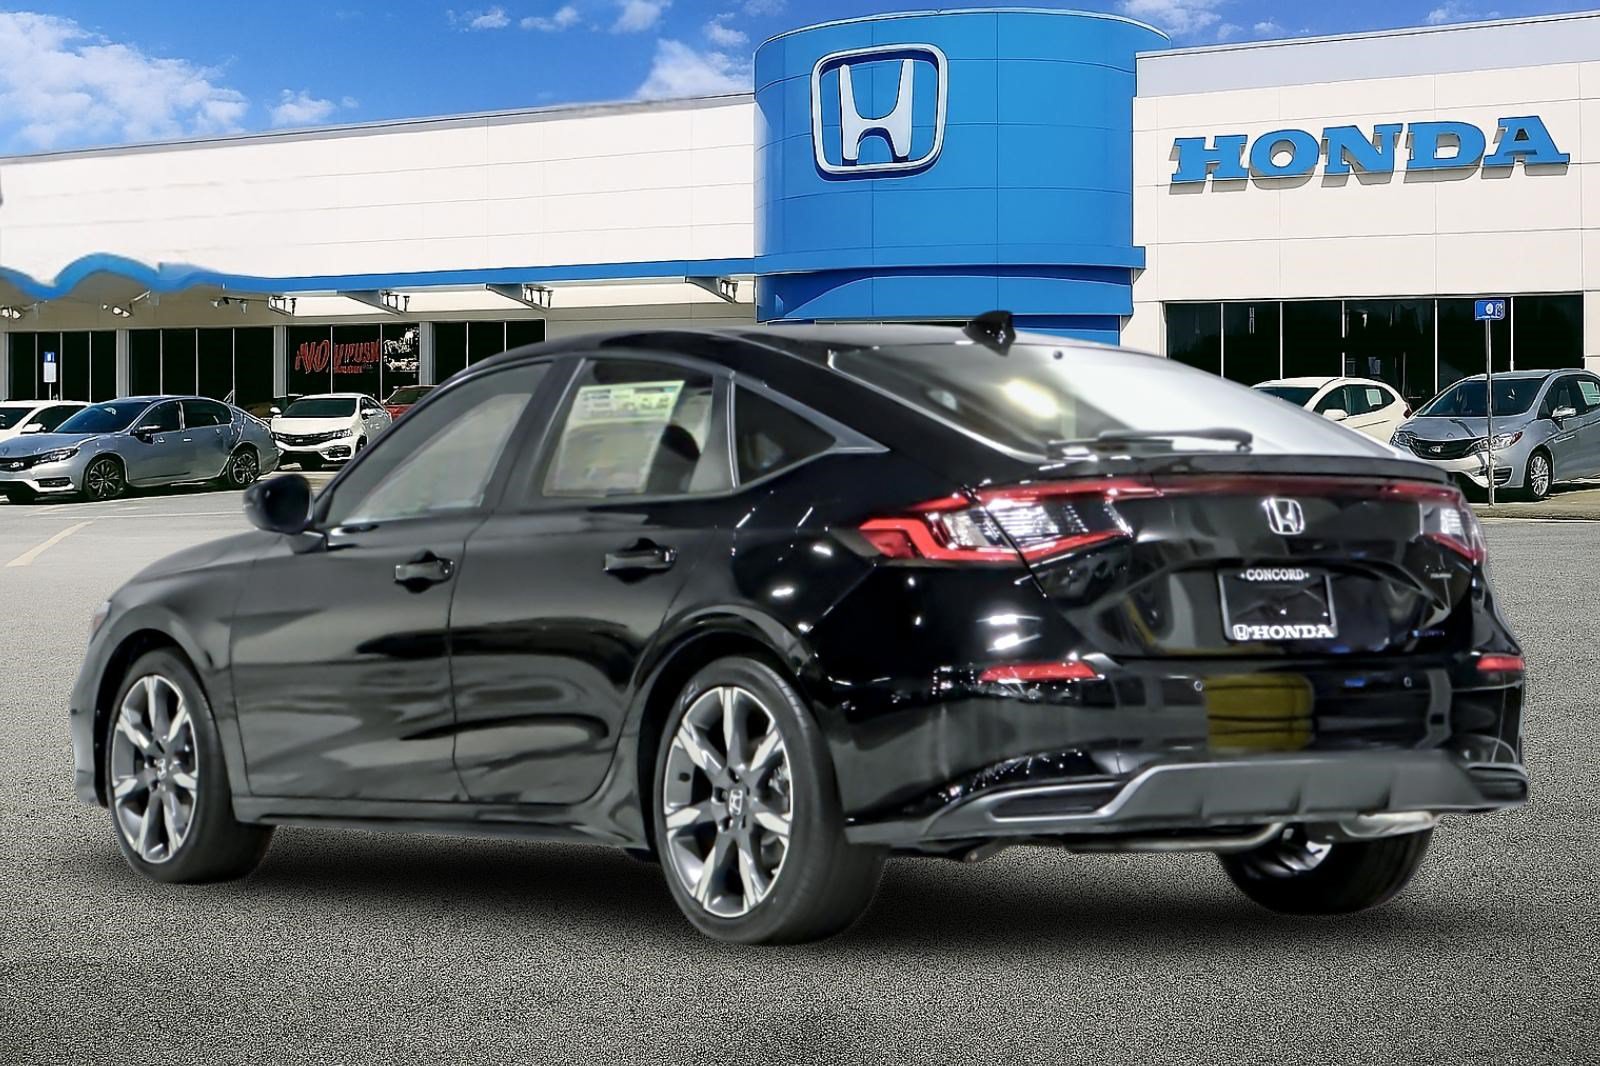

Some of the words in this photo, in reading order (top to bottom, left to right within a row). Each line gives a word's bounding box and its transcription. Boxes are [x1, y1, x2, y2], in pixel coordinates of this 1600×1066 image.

[1171, 115, 1570, 184] HONDA
[1246, 568, 1305, 581] CONCORD
[1251, 624, 1335, 640] HONDA
